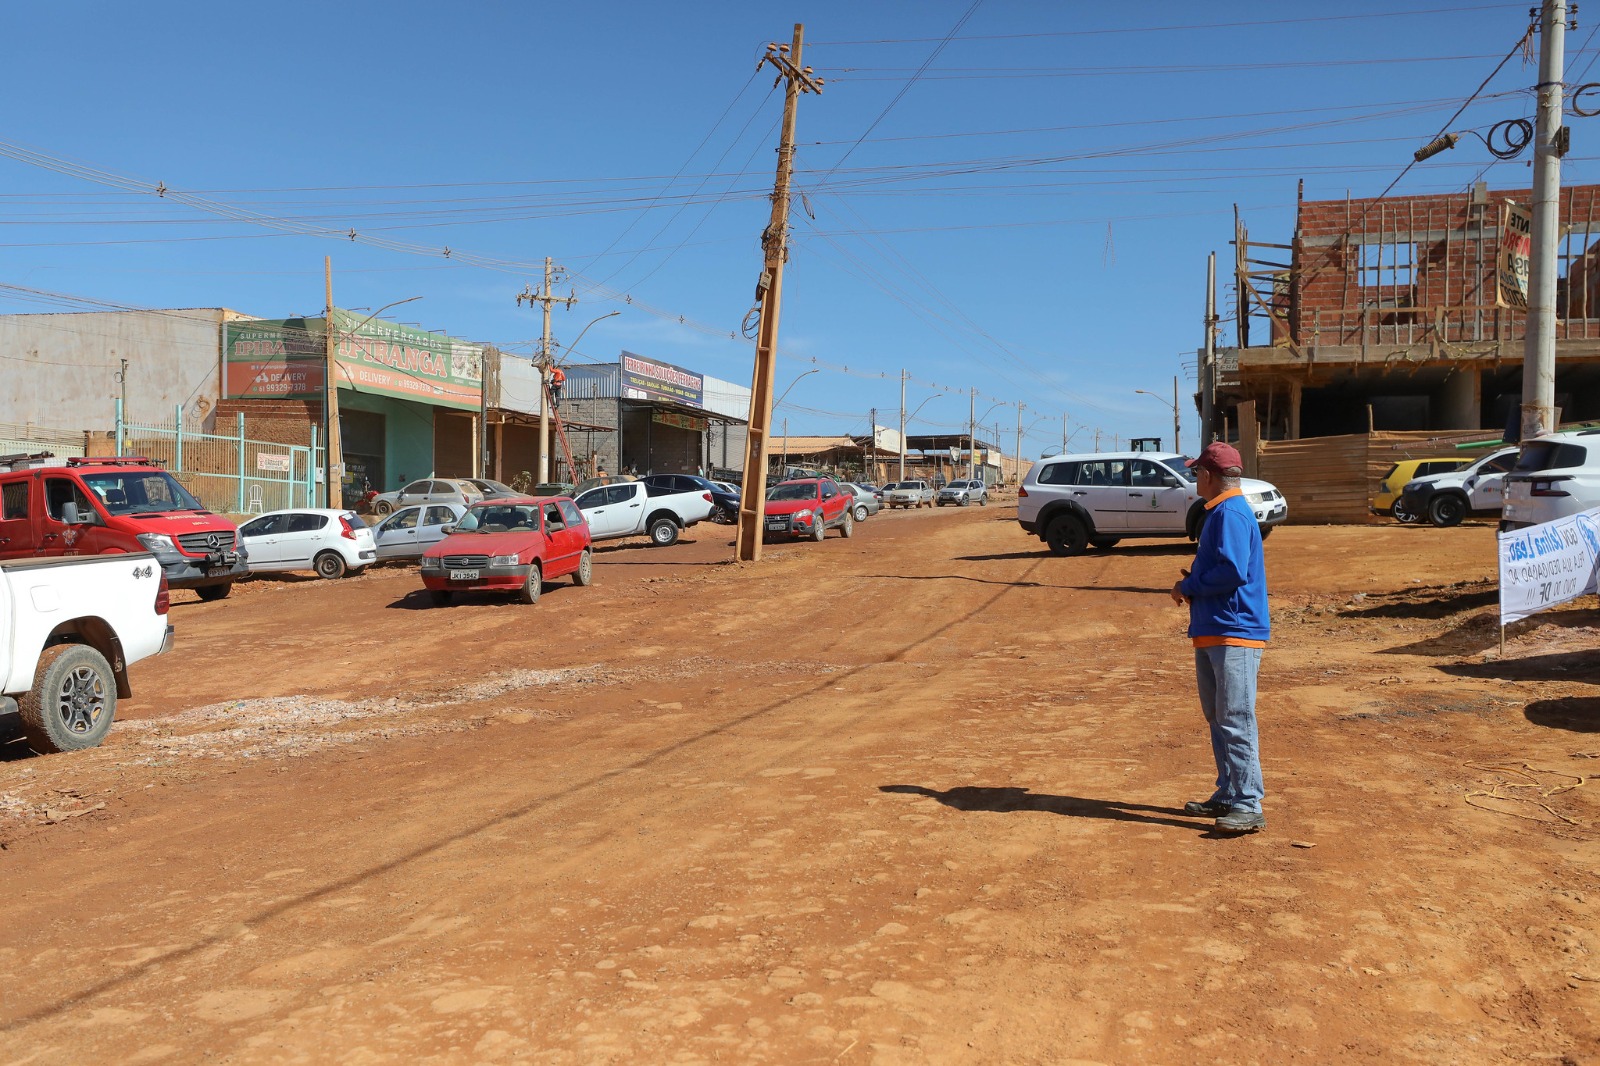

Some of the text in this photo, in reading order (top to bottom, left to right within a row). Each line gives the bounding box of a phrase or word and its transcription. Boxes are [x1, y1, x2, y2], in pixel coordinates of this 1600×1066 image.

[346, 317, 442, 349] SUPERMERCADOS
[338, 329, 448, 378] IPIRANGA
[270, 373, 306, 382] DELIVERY
[359, 370, 391, 386] DELIVERY
[266, 383, 306, 392] 99329-7378
[132, 565, 153, 579] 4x4
